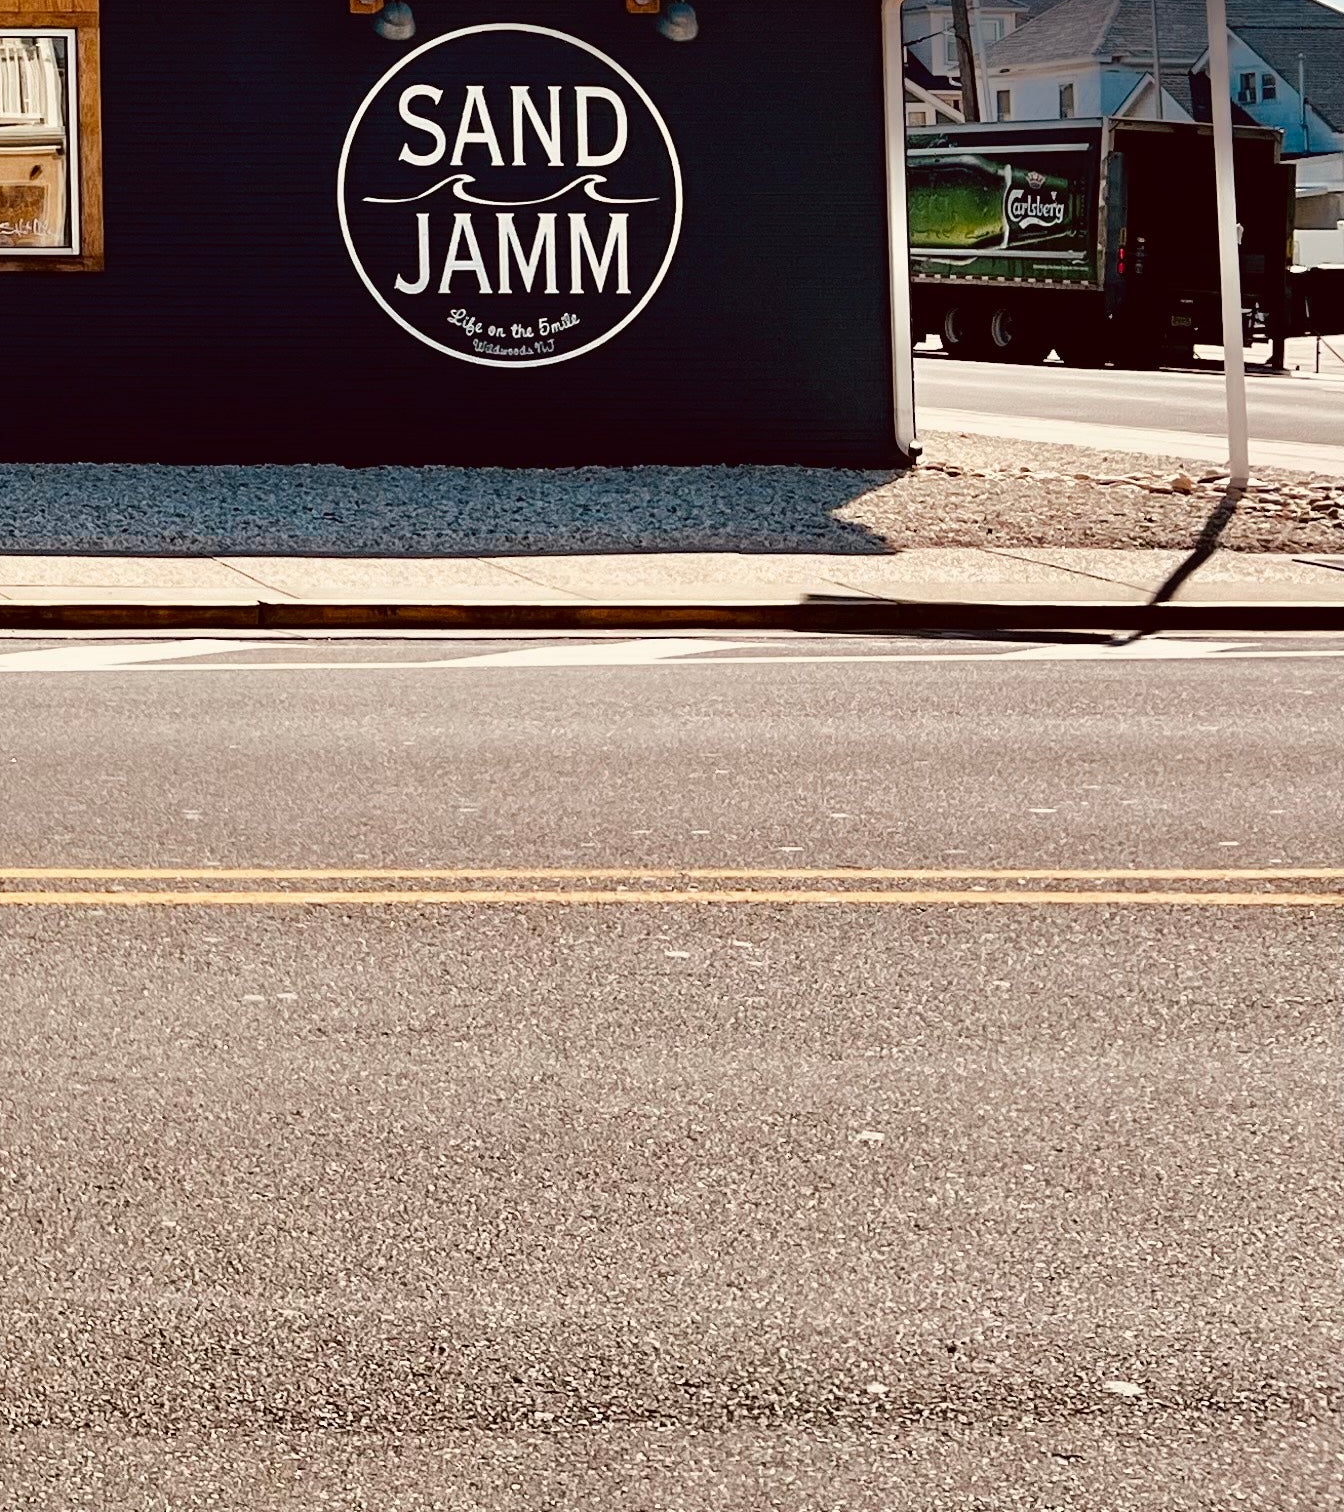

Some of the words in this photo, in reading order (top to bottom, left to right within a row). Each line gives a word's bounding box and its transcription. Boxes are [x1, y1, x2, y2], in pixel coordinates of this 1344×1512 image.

[398, 84, 628, 167] SAND
[1007, 189, 1064, 226] Carlsberg
[394, 212, 631, 294] JAMM
[447, 308, 483, 336] Life
[487, 325, 506, 338] on
[510, 323, 534, 338] the
[473, 338, 534, 356] Wildwoods
[534, 338, 555, 353] NJ
